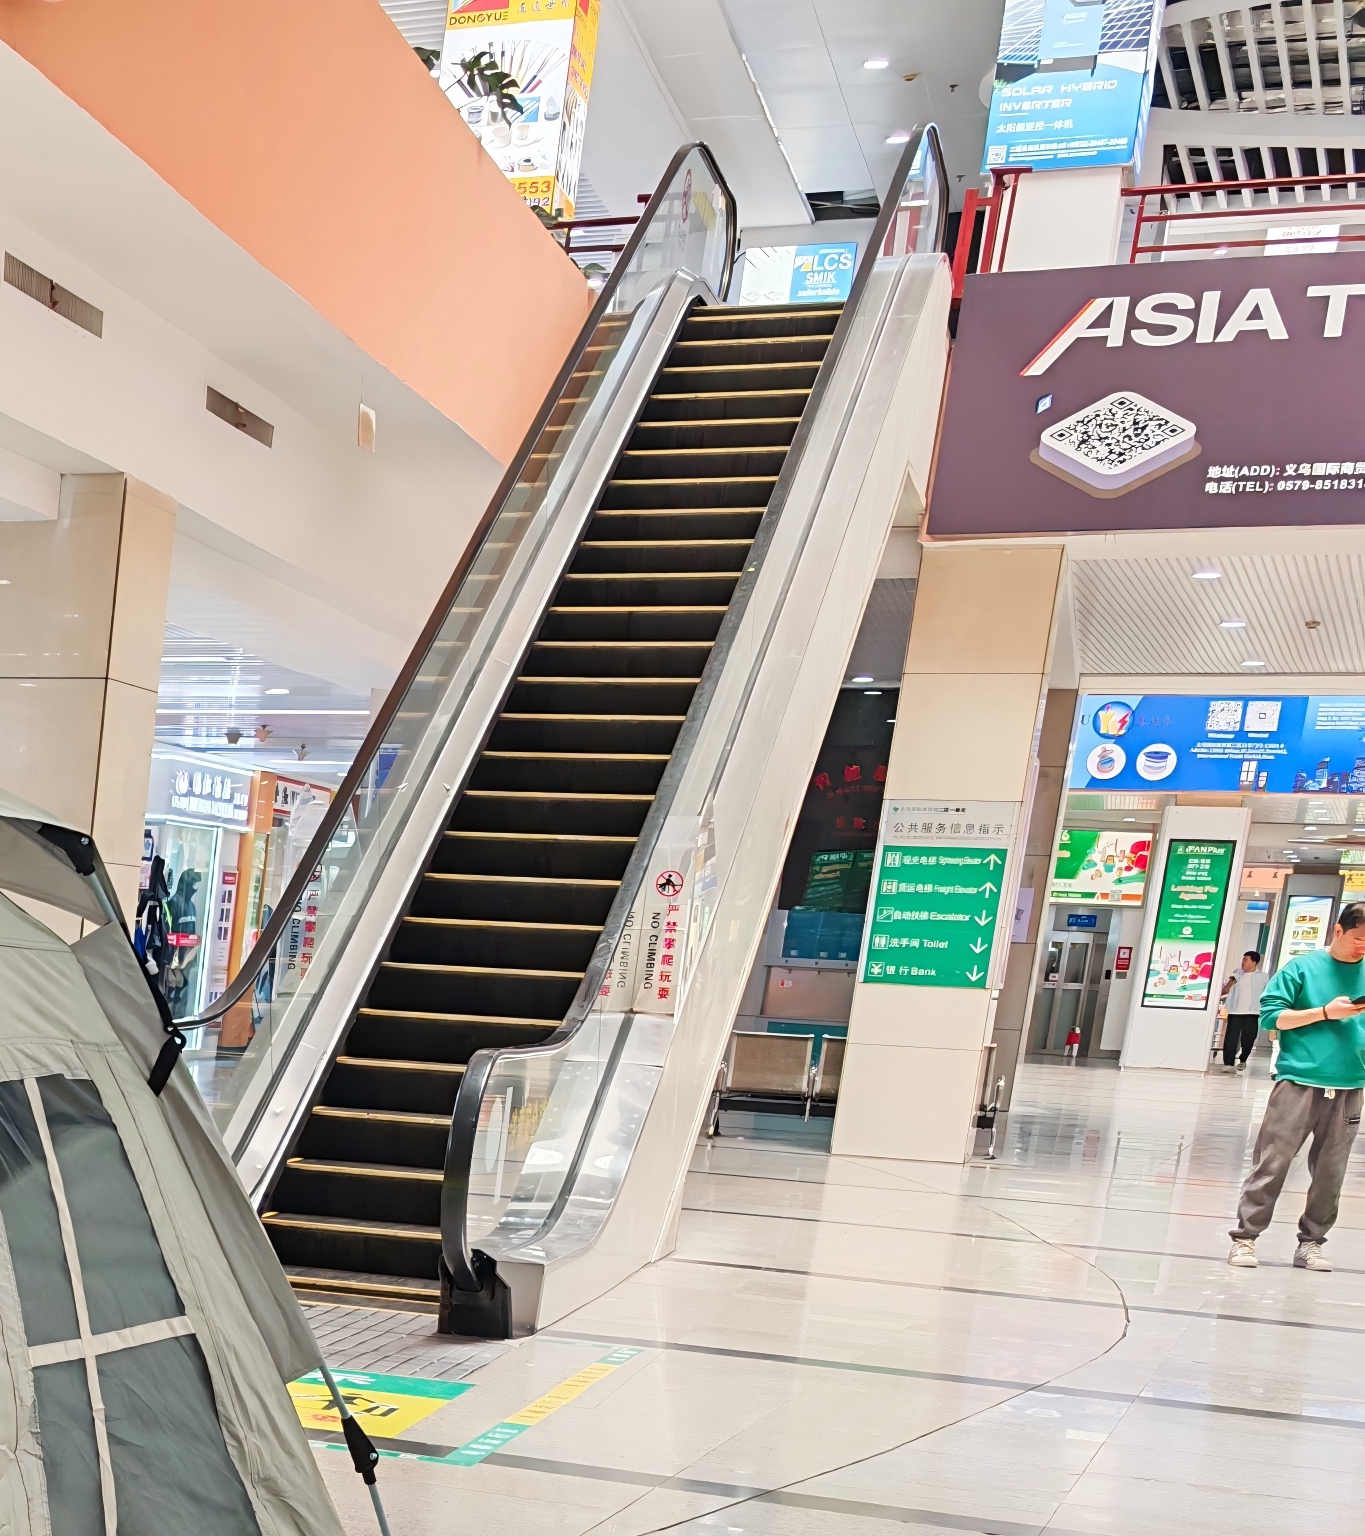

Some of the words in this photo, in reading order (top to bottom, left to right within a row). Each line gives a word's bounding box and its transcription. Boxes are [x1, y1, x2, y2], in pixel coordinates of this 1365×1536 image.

[1001, 85, 1053, 97] SOLAR
[1060, 80, 1118, 93] HYBRID
[999, 98, 1073, 112] INVERTER
[813, 253, 852, 271] LCS
[1019, 288, 1289, 377] ASIA
[1277, 479, 1365, 491] 0579-851831
[893, 822, 1005, 835] 公共服务信息指示
[650, 911, 661, 929] NO
[287, 918, 301, 970] CLIMBING
[889, 937, 920, 949] 洗手间
[923, 939, 949, 949] Toilet
[643, 934, 659, 990] CLIMBING
[886, 965, 910, 976] 银行
[910, 966, 937, 977] Bank
